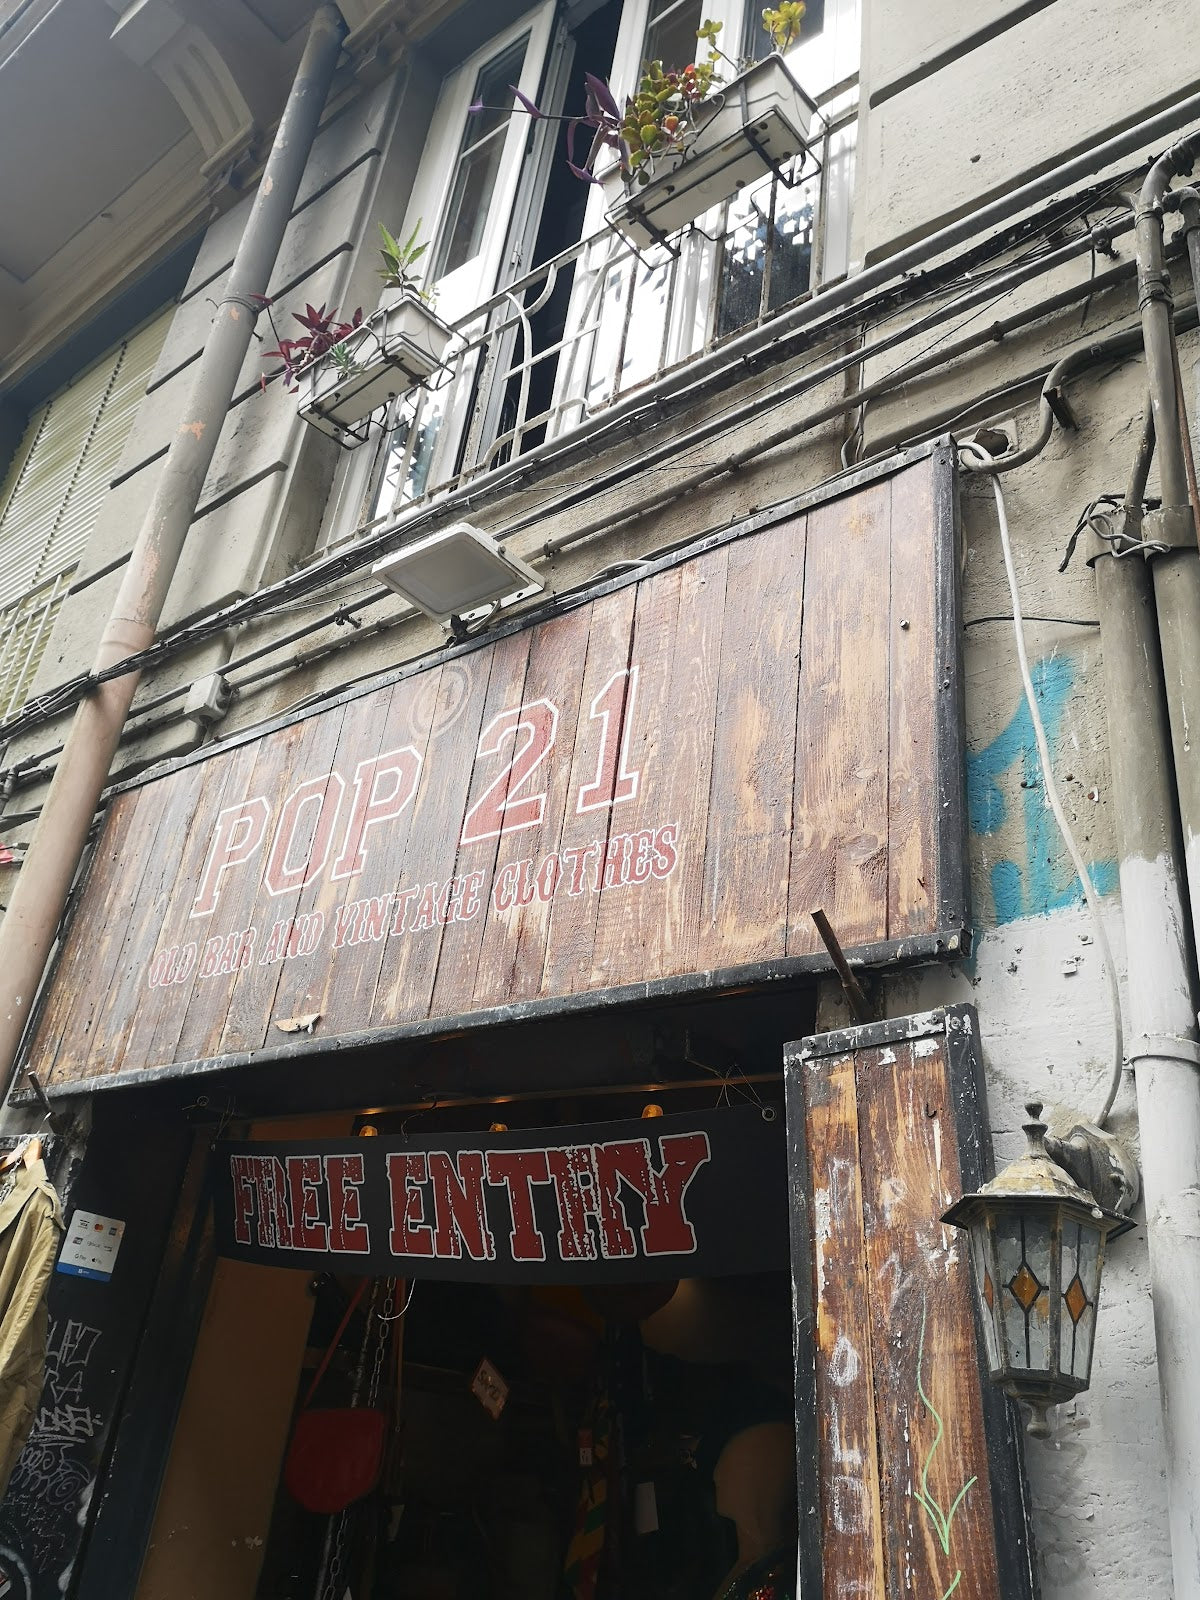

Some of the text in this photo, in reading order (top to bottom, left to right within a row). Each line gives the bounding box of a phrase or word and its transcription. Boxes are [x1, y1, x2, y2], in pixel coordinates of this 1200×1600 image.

[190, 745, 423, 918] POP
[460, 664, 639, 845] 21
[148, 822, 679, 989] OLD BAR AND VINTAGE CLOTHES
[231, 1154, 371, 1254] FREE
[386, 1131, 711, 1261] ENTRY
